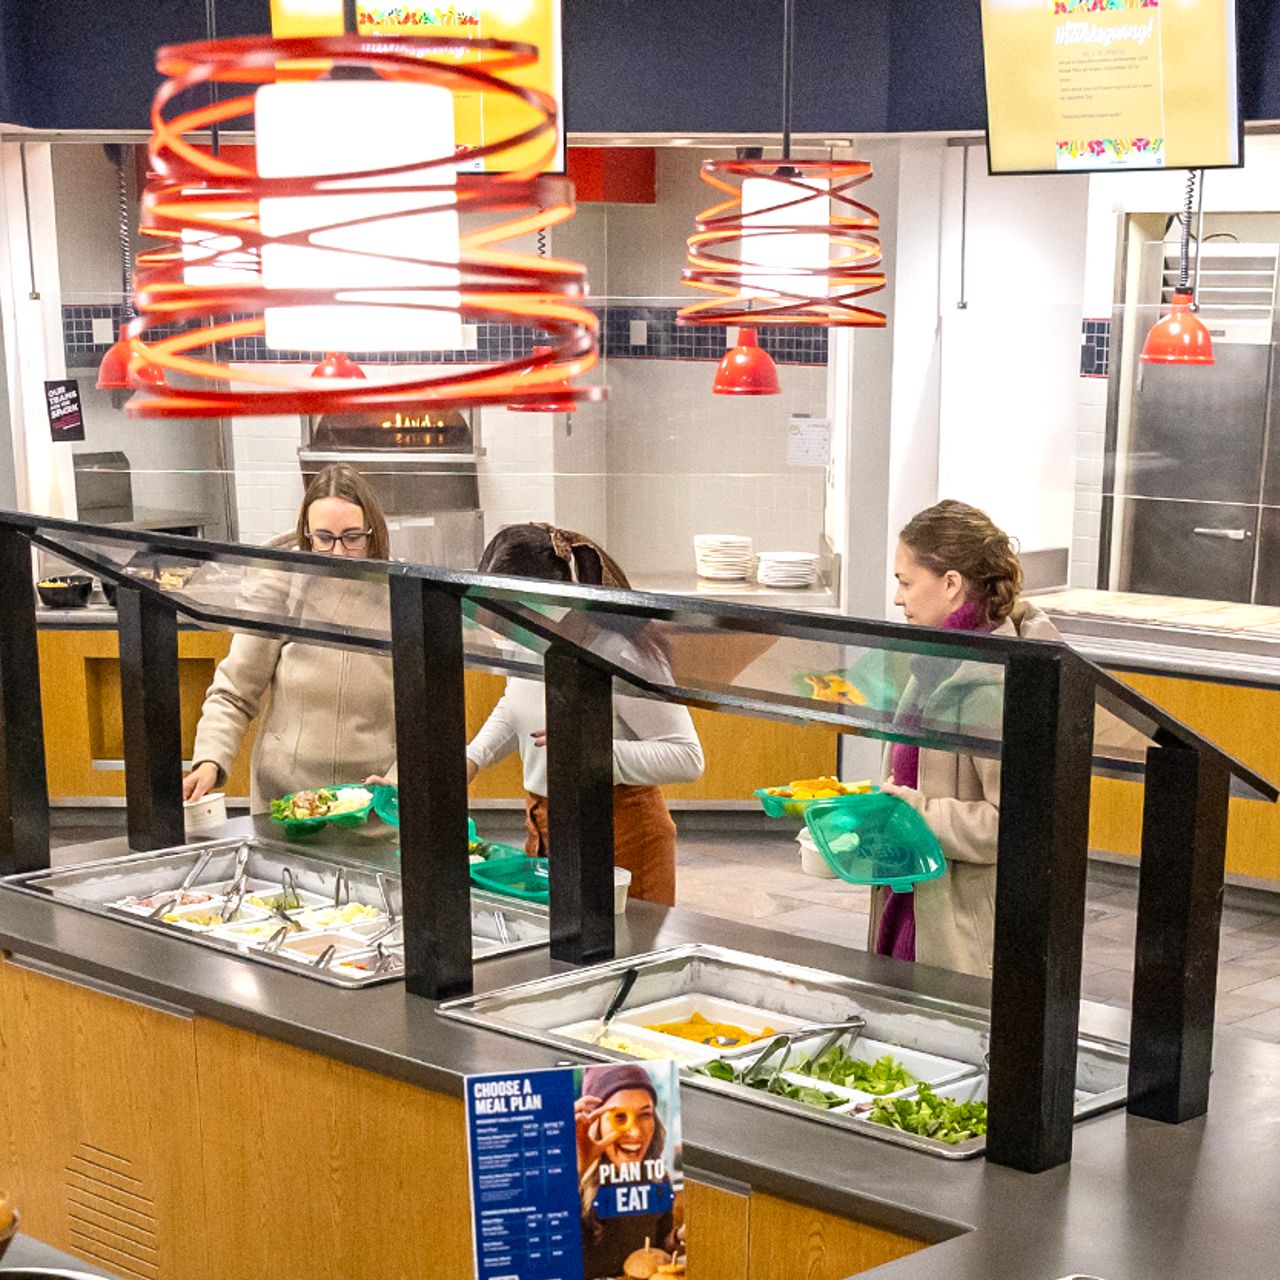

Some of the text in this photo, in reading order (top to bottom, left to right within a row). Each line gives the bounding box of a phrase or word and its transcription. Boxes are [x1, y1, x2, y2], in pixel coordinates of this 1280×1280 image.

[474, 1078, 532, 1098] CHOOSE A
[475, 1094, 543, 1115] MEAL PLAN
[599, 1158, 666, 1185] PLAN TO
[616, 1185, 651, 1212] EAT
